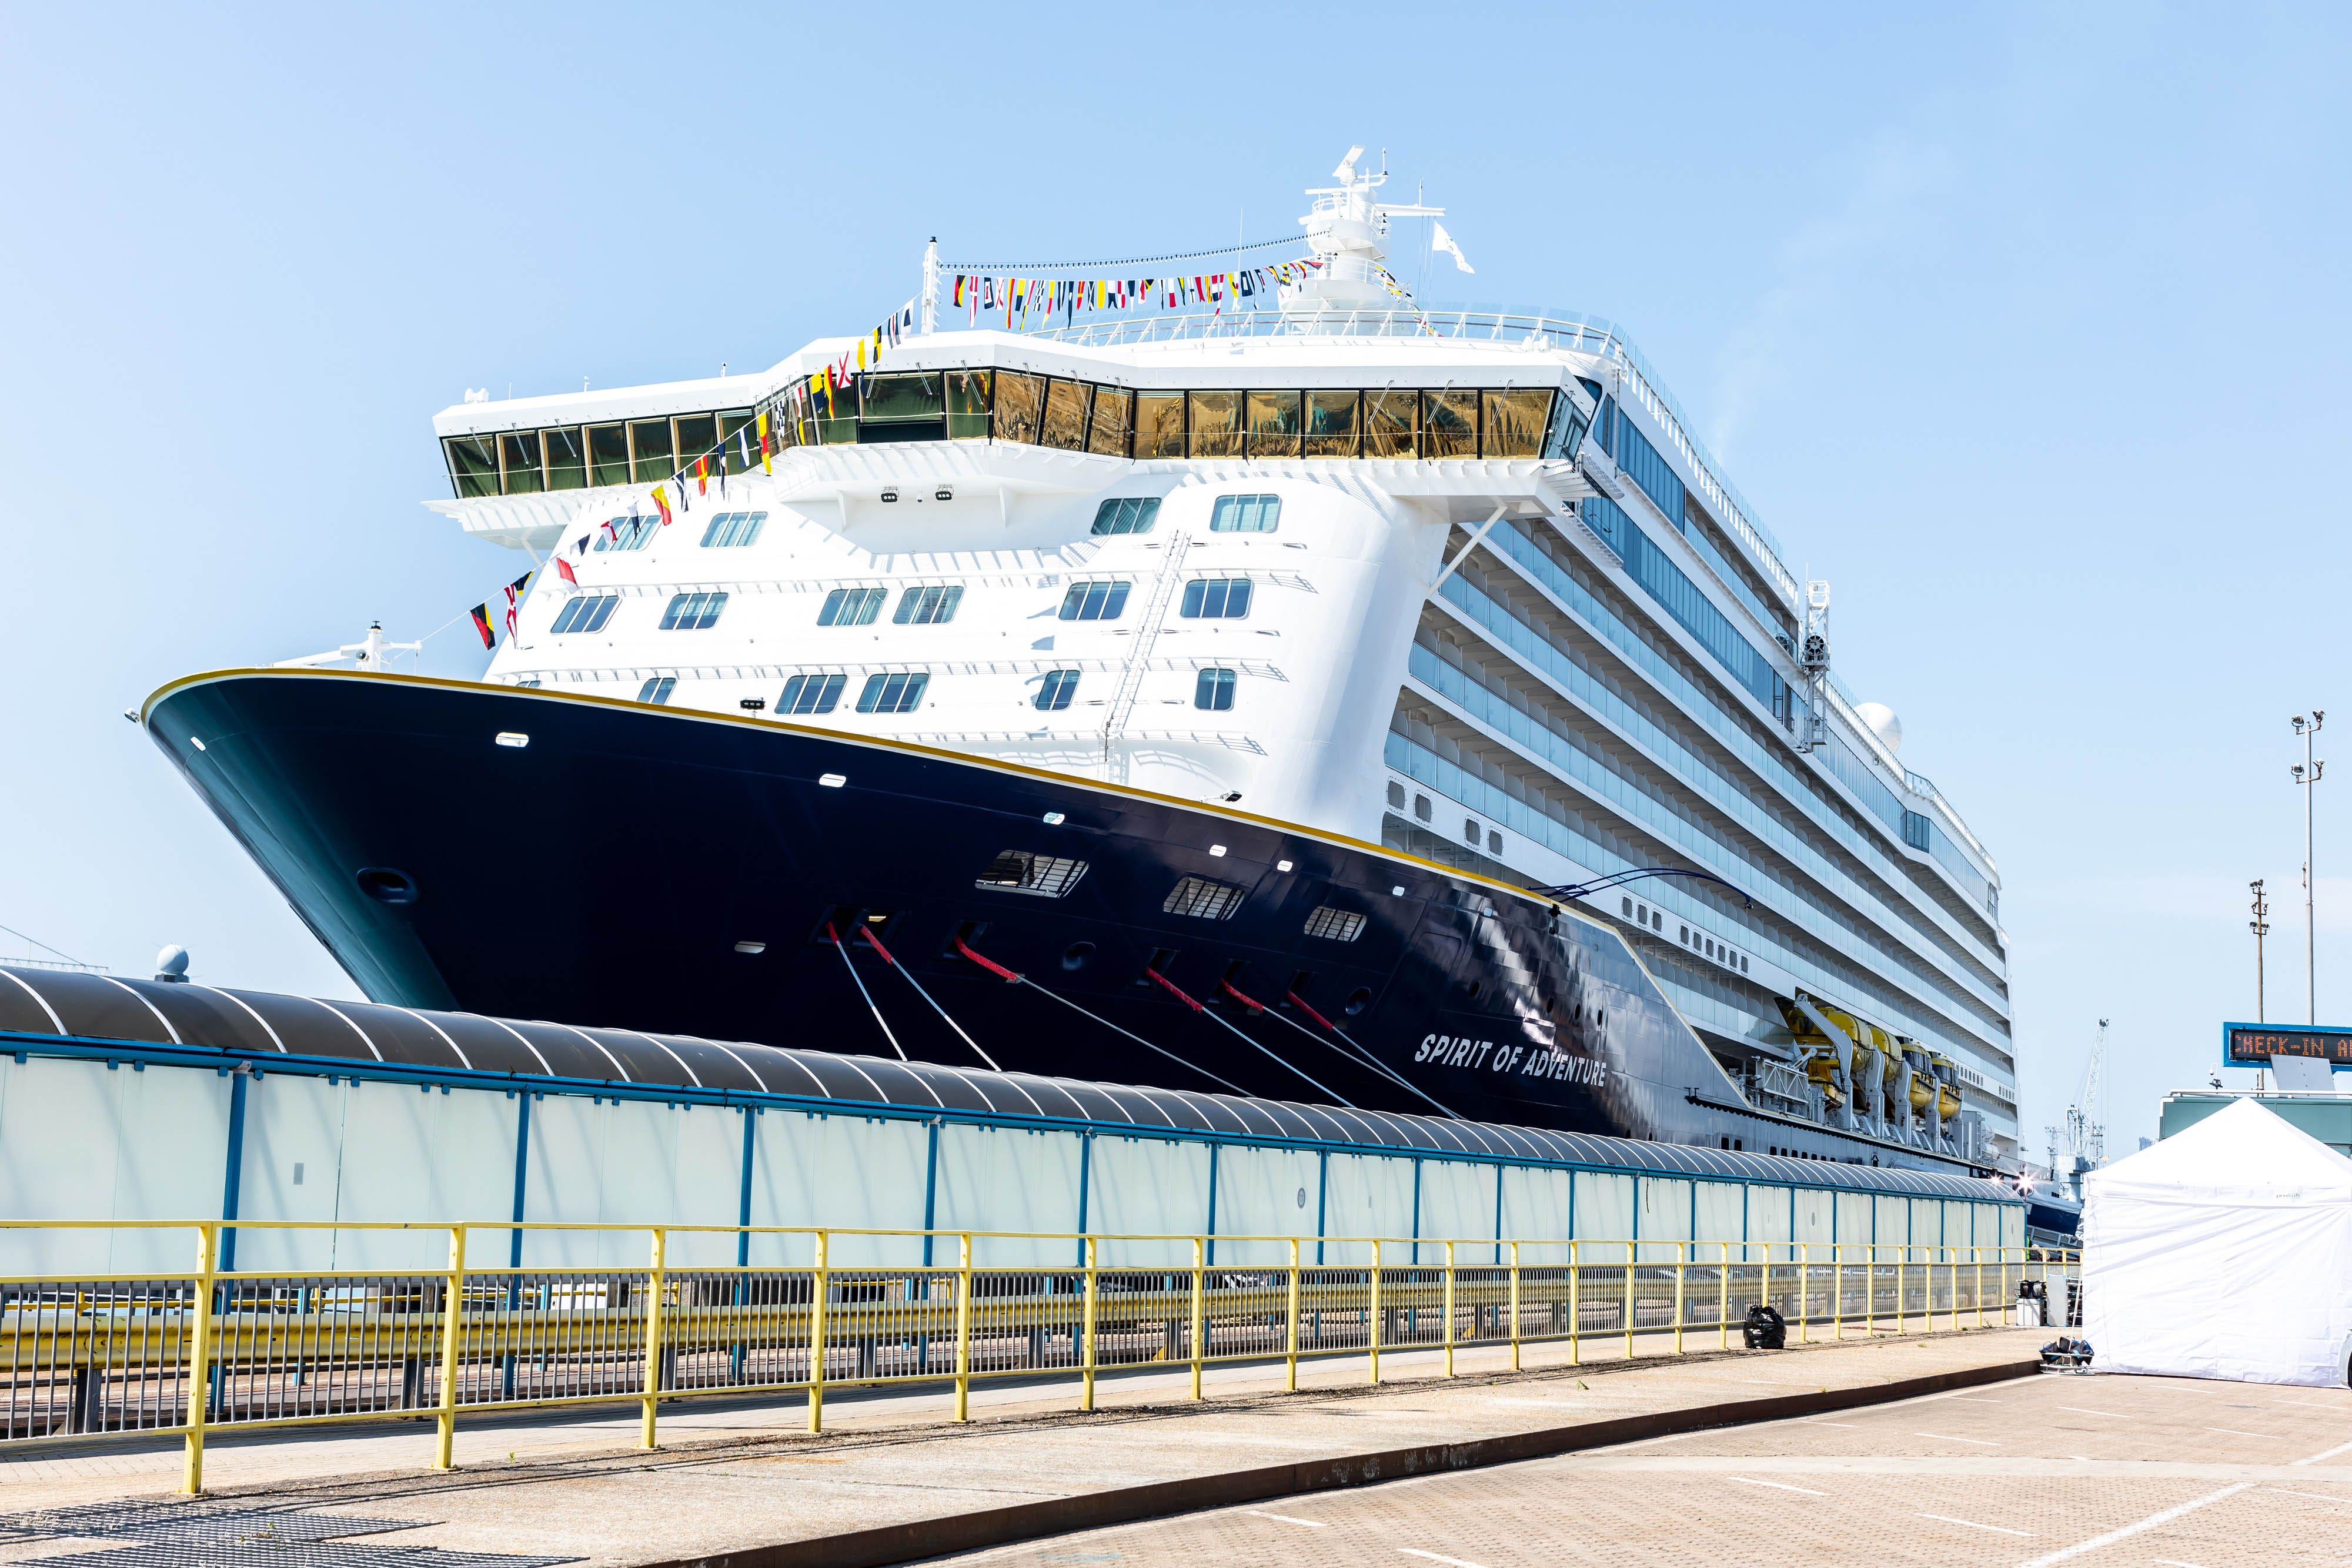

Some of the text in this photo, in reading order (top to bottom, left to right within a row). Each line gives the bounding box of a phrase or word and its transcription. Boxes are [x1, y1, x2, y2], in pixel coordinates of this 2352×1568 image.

[1415, 1034, 1606, 1087] SPIRIT OF ADVENTURE
